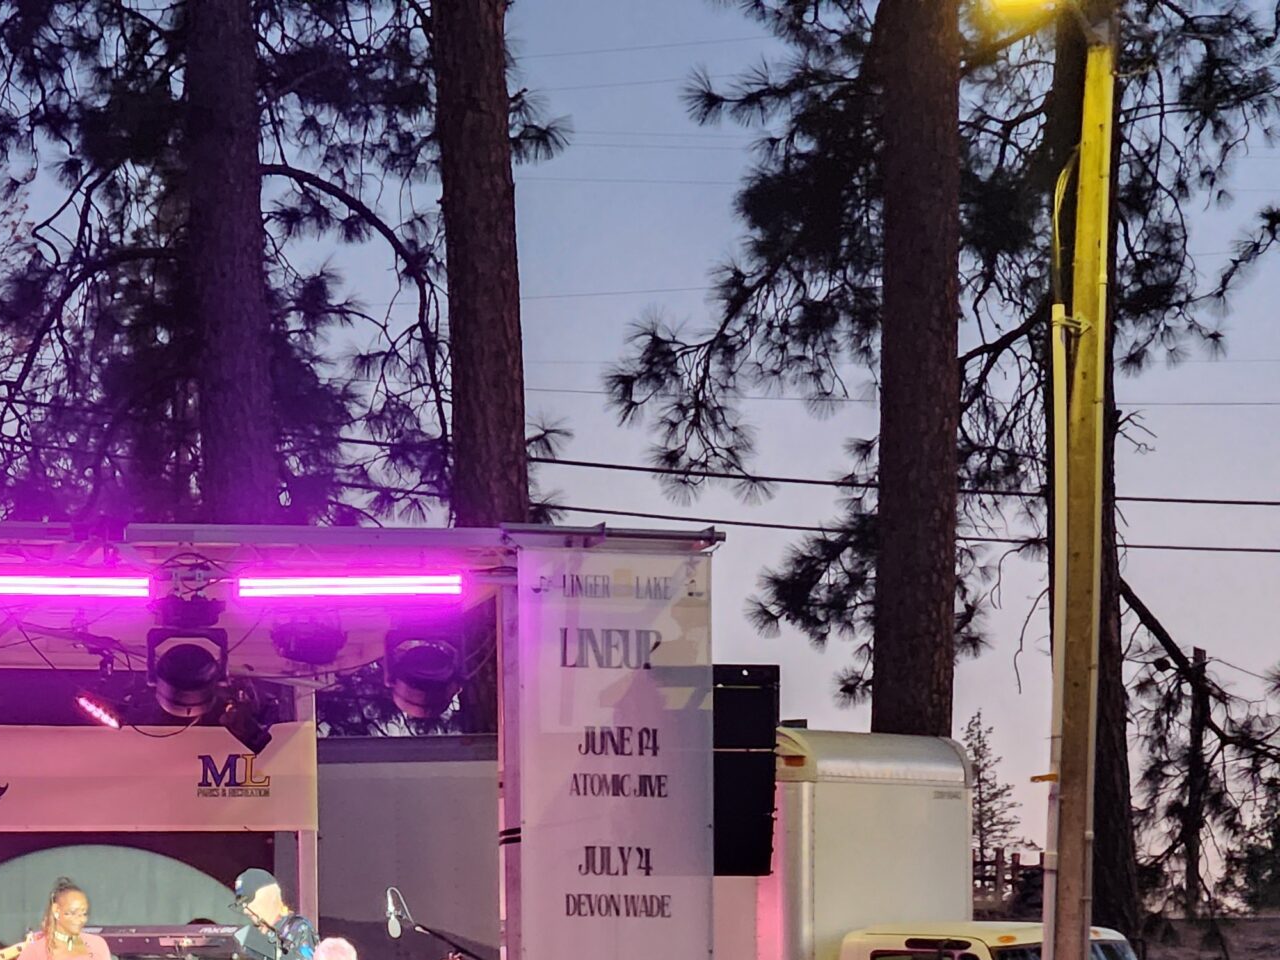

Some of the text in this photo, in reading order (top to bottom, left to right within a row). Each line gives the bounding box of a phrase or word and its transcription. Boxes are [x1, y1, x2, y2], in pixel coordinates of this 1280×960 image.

[562, 573, 673, 601] LINGER LAKE
[559, 627, 662, 670] LINEUP
[577, 725, 660, 757] JUNE 14
[197, 753, 271, 788] ML
[569, 772, 669, 799] ATOMIC JIVE
[577, 845, 653, 877] JULY 4
[565, 893, 672, 919] DEVON WADE
